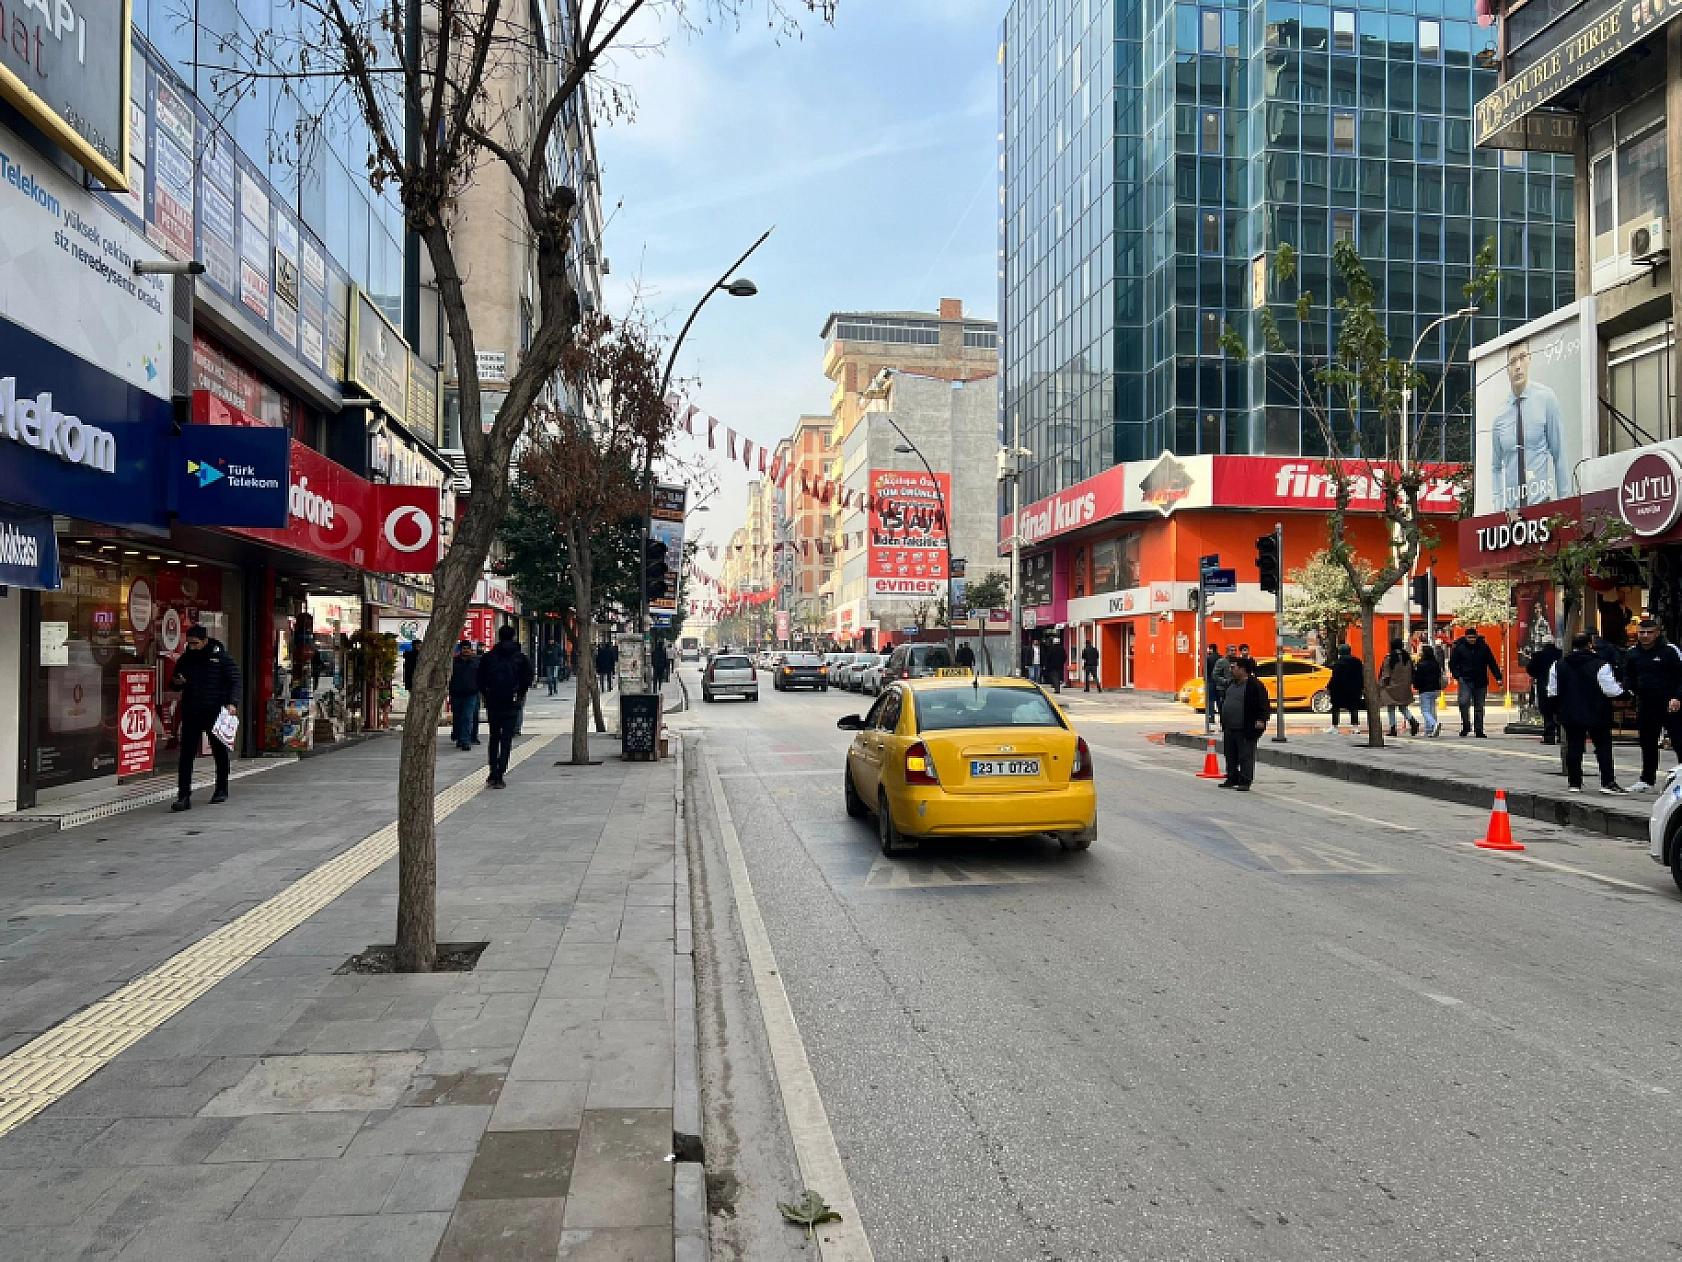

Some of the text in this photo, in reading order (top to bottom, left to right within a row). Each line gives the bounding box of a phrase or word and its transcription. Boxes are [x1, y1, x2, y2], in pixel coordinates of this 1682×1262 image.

[1503, 7, 1623, 108] DOUBLE THREE
[0, 153, 61, 218] Telekom
[63, 209, 101, 247] yüksek
[54, 229, 69, 252] siz
[71, 242, 137, 297] neredeyseniz
[0, 377, 116, 473] lekom
[228, 464, 255, 477] Türk
[228, 477, 279, 488] Telekom
[1506, 477, 1554, 500] TUDORS
[1054, 491, 1096, 531] kurs
[1476, 516, 1551, 552] TUDORS
[876, 580, 936, 592] evmer
[1109, 597, 1124, 613] ING
[978, 762, 993, 774] 23
